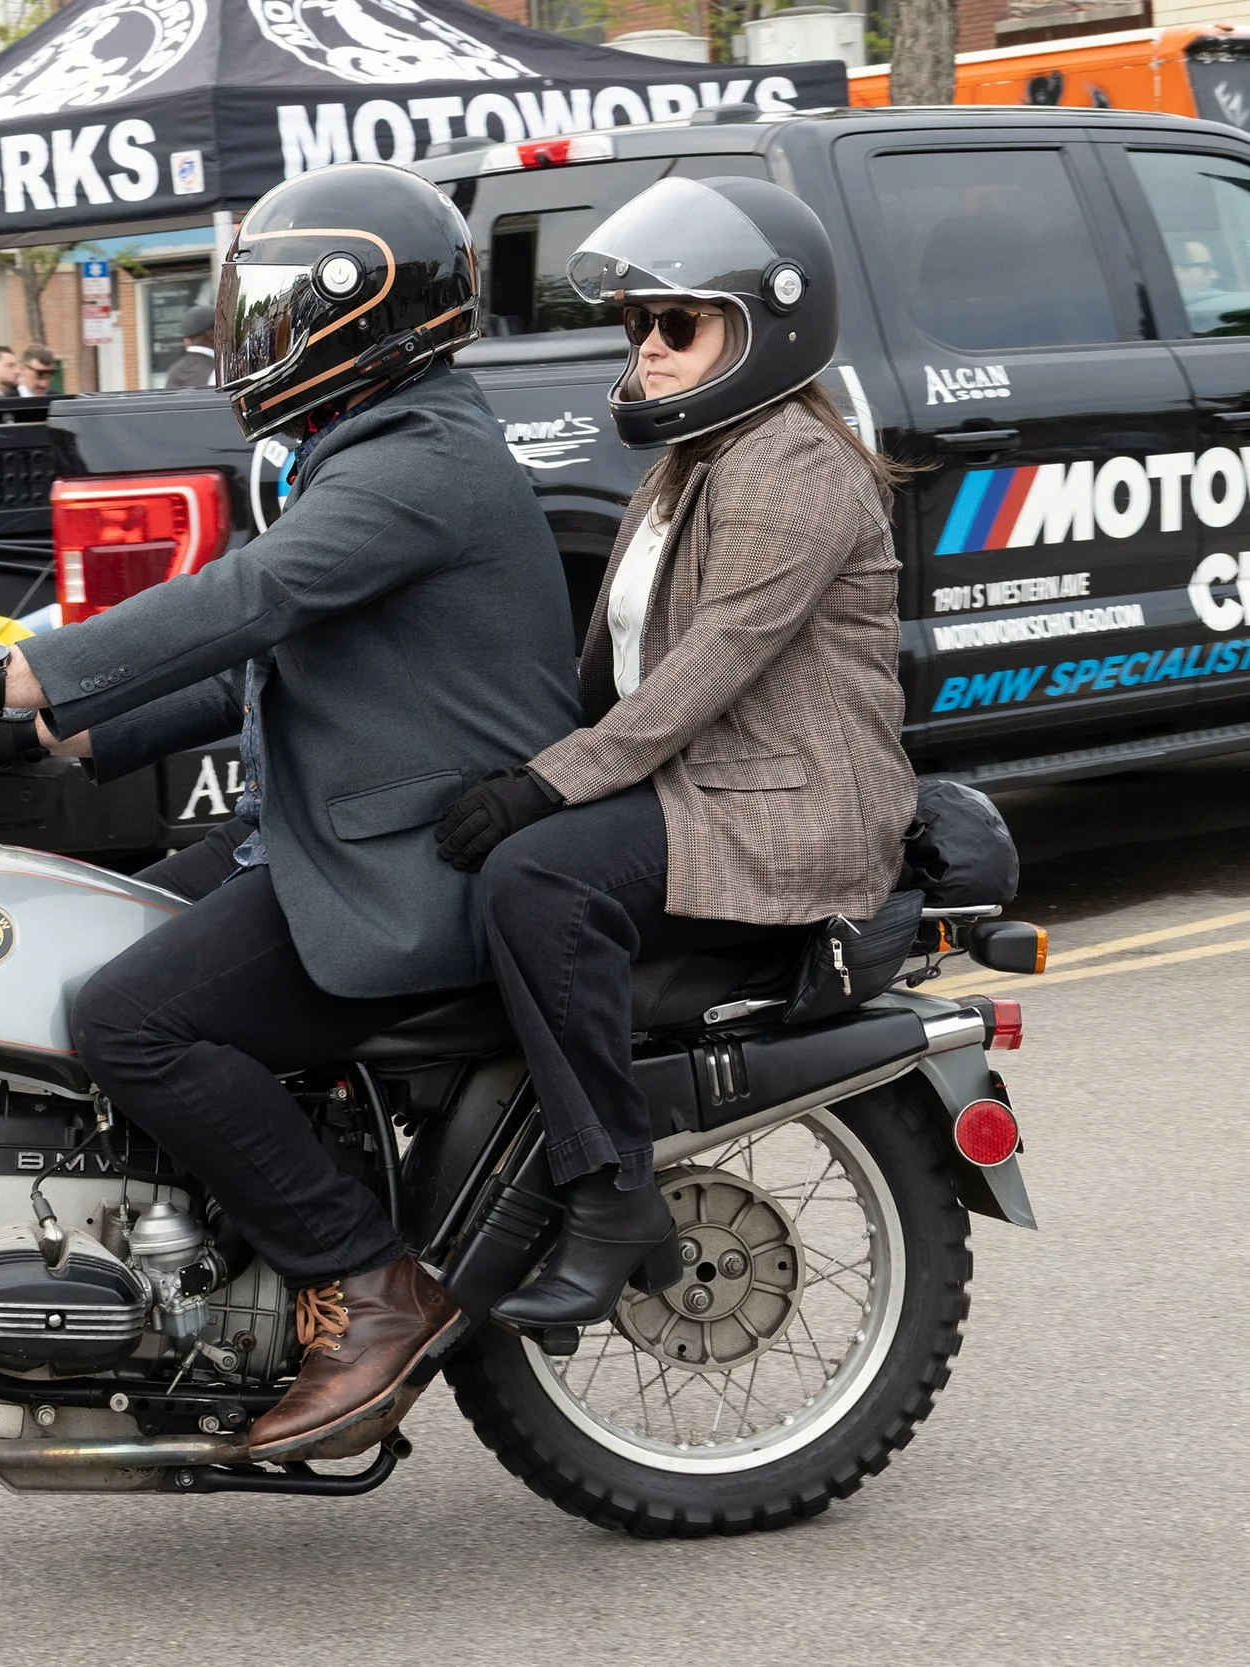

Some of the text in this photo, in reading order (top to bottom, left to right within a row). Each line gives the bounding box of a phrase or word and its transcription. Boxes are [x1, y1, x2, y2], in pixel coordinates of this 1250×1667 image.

[924, 365, 1011, 405] ALCAN
[1006, 446, 1250, 549] MOTO
[986, 576, 1060, 606] WESTERN
[931, 665, 1047, 713] BMW
